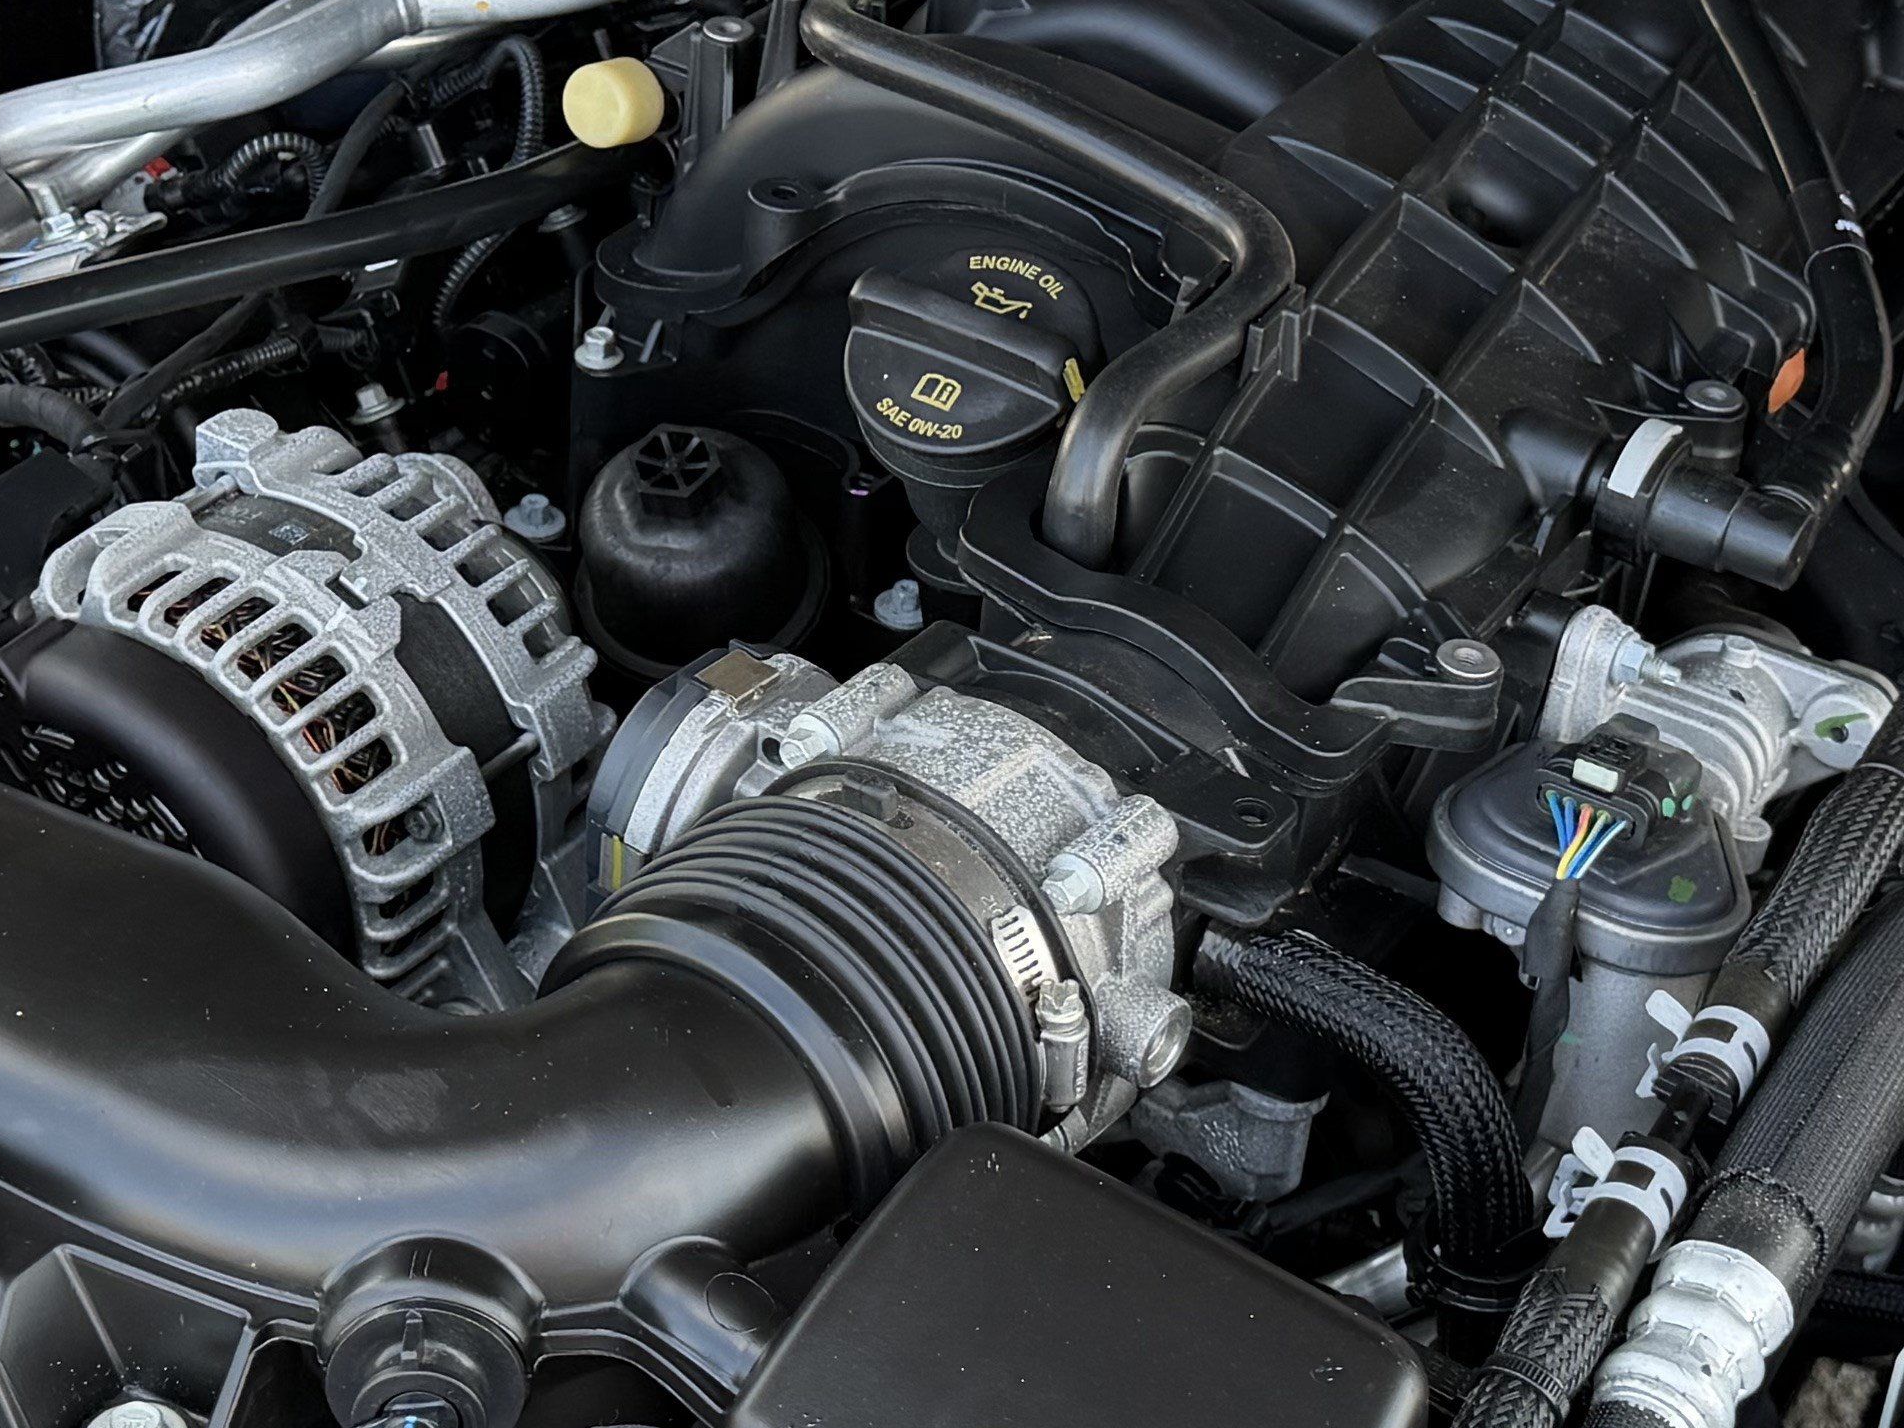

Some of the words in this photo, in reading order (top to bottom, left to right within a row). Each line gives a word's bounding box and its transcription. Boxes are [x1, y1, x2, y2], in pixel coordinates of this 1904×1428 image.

[969, 255, 1042, 280] ENGINE
[1038, 274, 1064, 300] OIL
[876, 397, 912, 427] SAE
[908, 418, 963, 439] 0W-20
